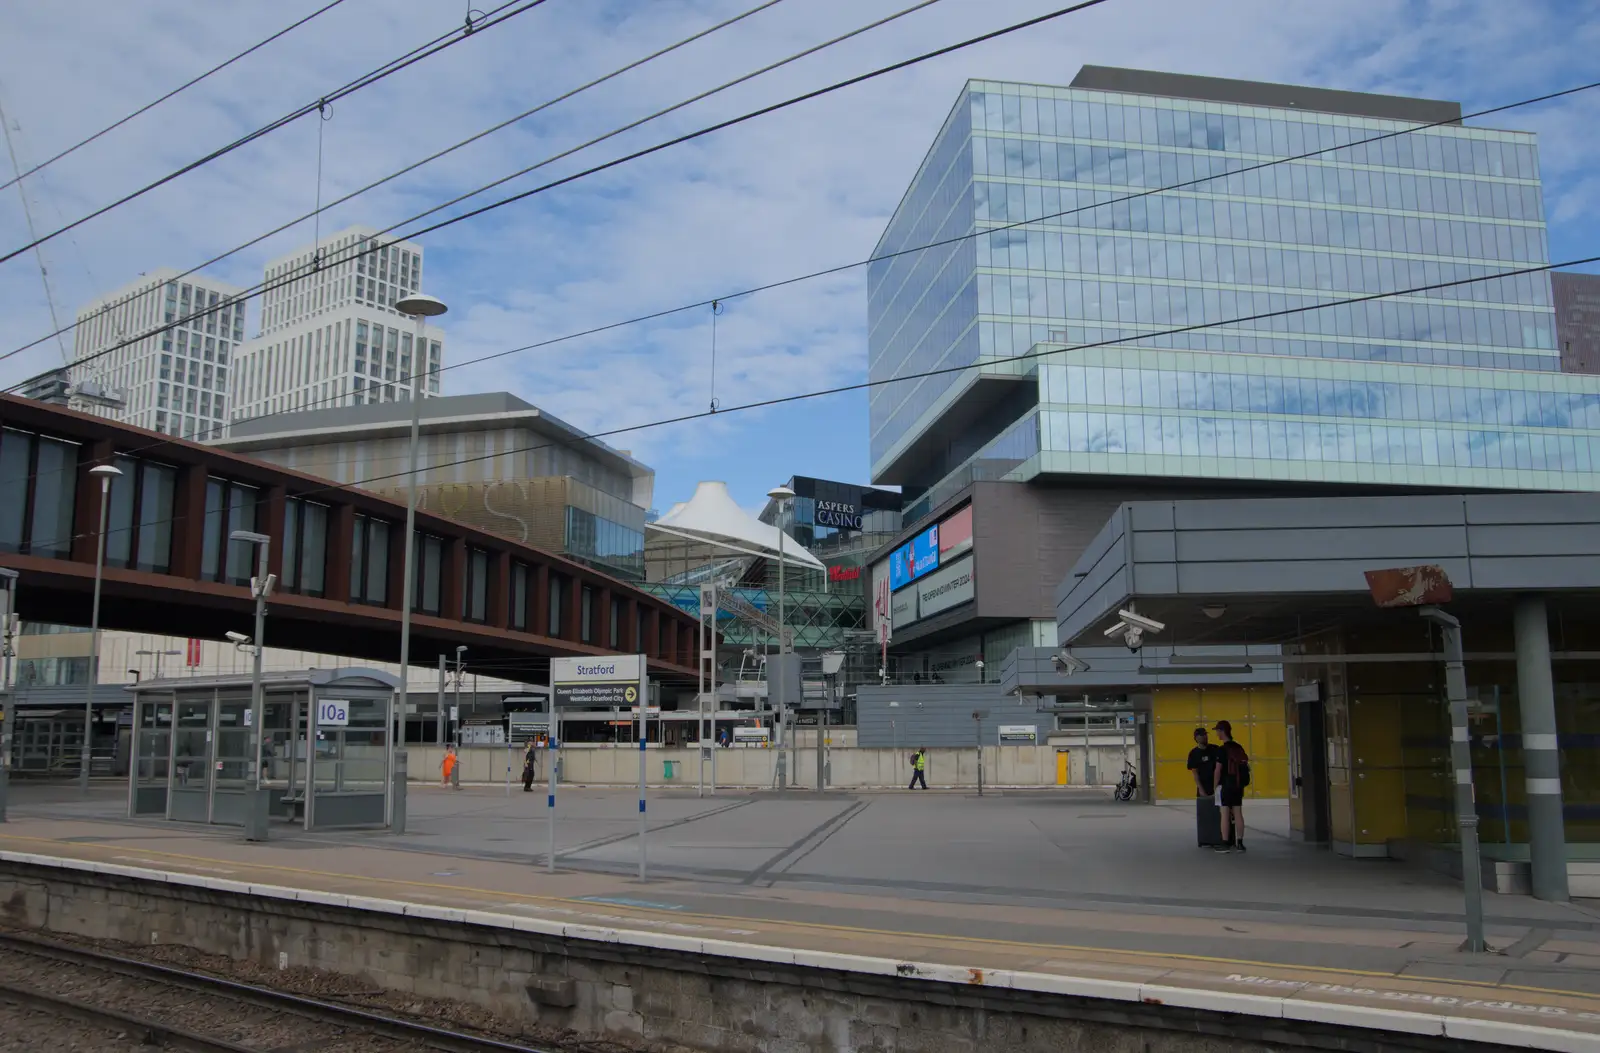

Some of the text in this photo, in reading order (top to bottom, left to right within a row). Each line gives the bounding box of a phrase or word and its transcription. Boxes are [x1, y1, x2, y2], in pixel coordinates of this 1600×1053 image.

[818, 500, 855, 514] ASPERS
[818, 510, 864, 528] CASINO
[577, 664, 615, 676] Stratford
[572, 687, 594, 695] Elizabeth
[594, 687, 613, 696] Olympic
[613, 695, 624, 703] City
[322, 704, 345, 721] 10a
[1225, 974, 1309, 989] Mind
